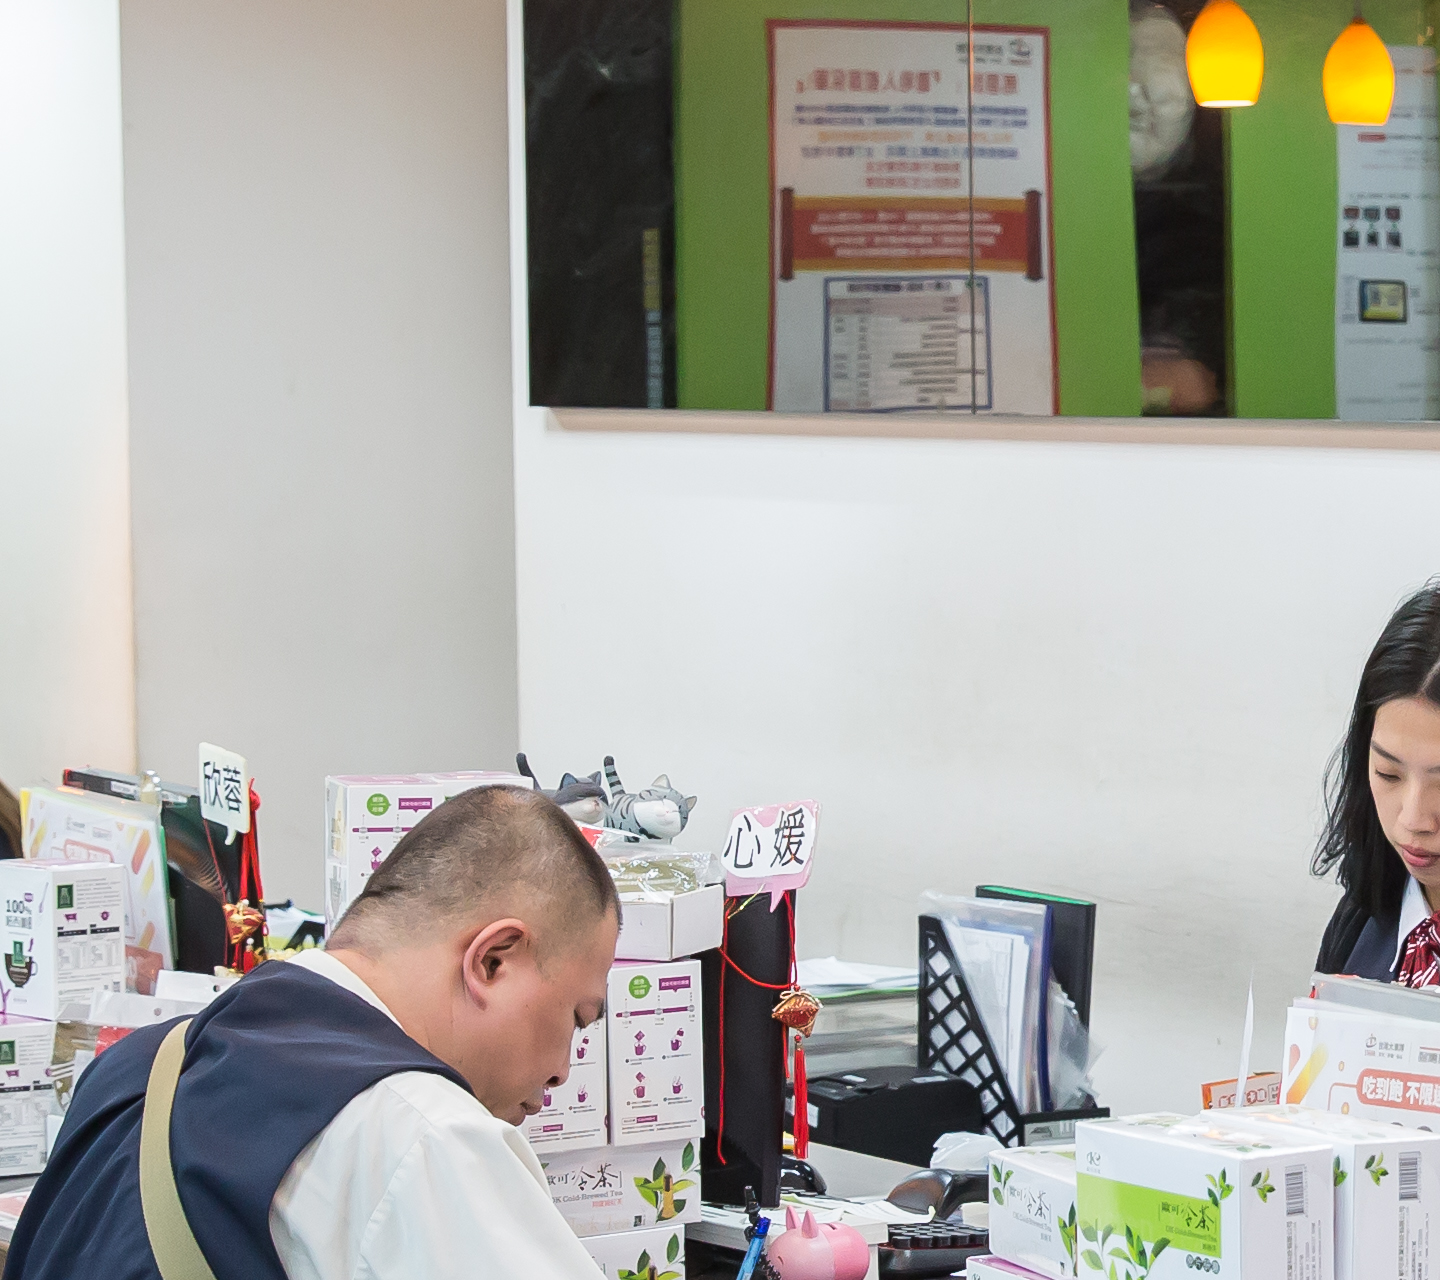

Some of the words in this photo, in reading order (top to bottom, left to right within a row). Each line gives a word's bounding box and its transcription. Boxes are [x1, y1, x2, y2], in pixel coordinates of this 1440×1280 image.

[202, 760, 243, 814] 欣蓉
[723, 807, 806, 869] 心媛
[1362, 1075, 1404, 1102] 吃到飽
[1161, 1200, 1215, 1232] 歐可冷茶
